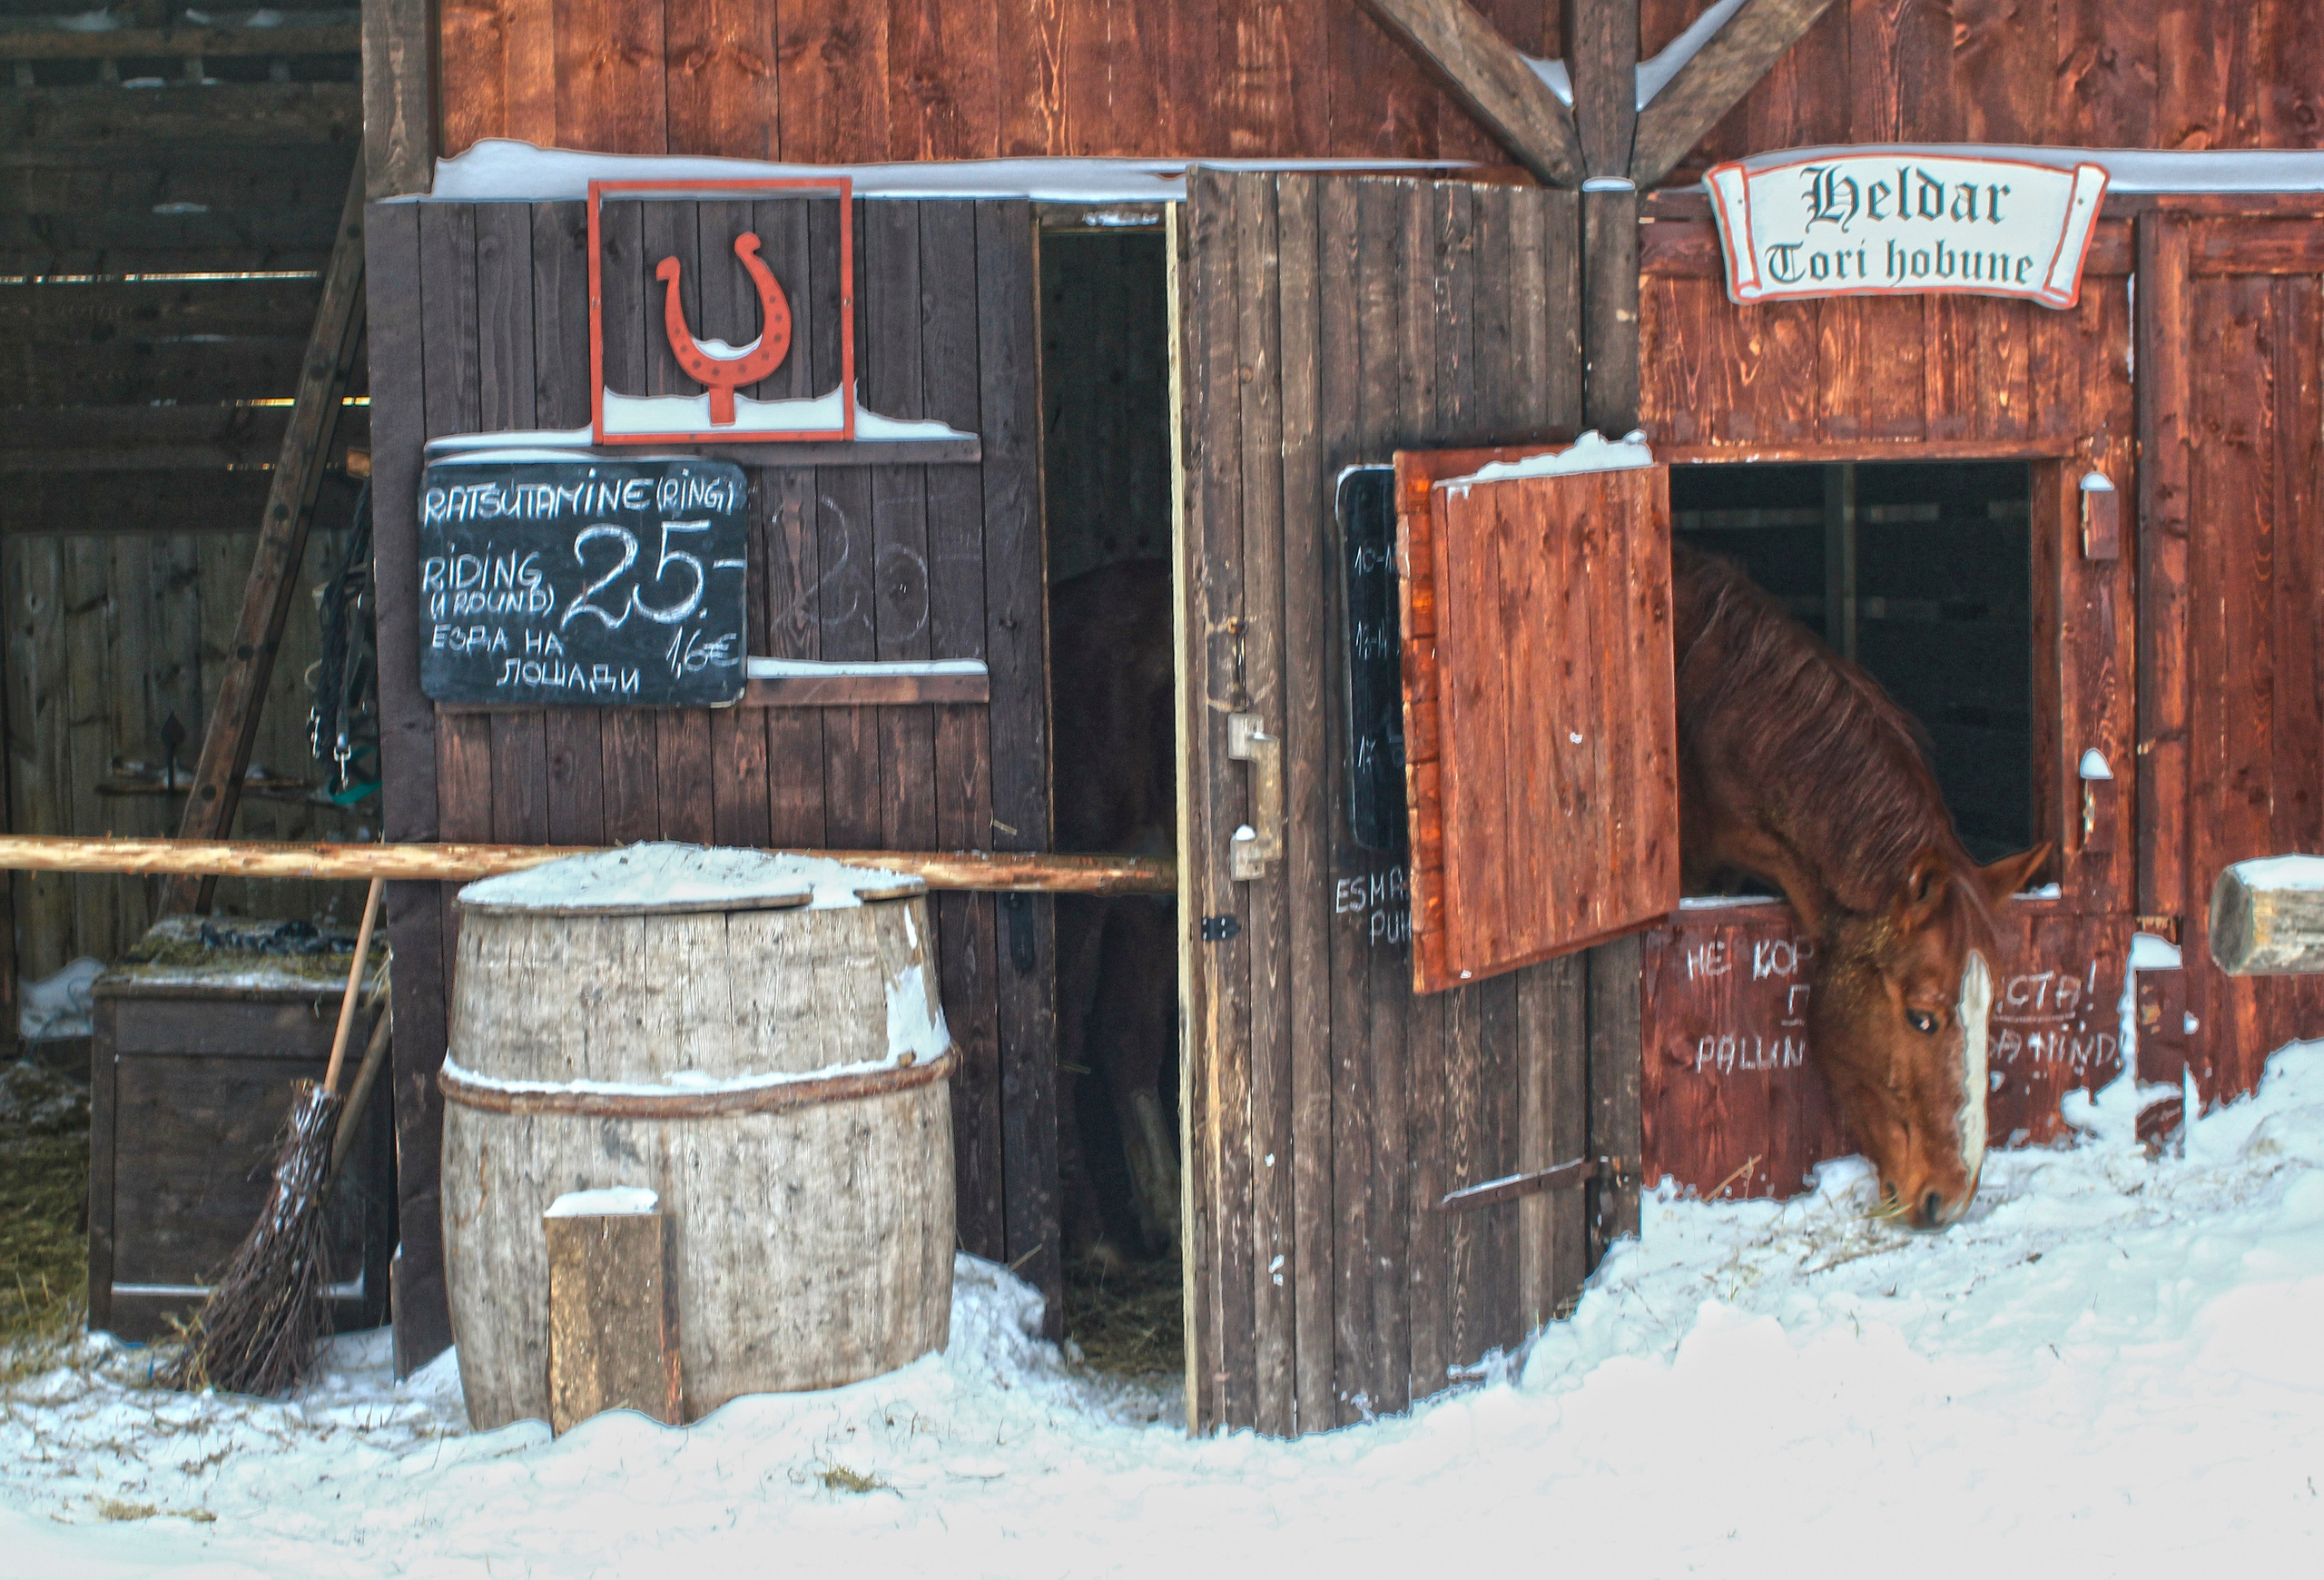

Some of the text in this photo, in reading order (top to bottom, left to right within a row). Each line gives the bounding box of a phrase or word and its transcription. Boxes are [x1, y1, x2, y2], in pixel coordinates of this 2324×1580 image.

[1800, 164, 2011, 233] Heldar
[1764, 239, 2034, 287] Tori hobune
[424, 468, 735, 528] RATSUTAMINE (RING)
[423, 540, 544, 593] RIDING
[453, 583, 556, 617] ROUND)
[432, 624, 565, 657] ЕЗДА НА
[496, 657, 640, 694] ЛОШАДИ
[1687, 941, 1732, 982] НЕ
